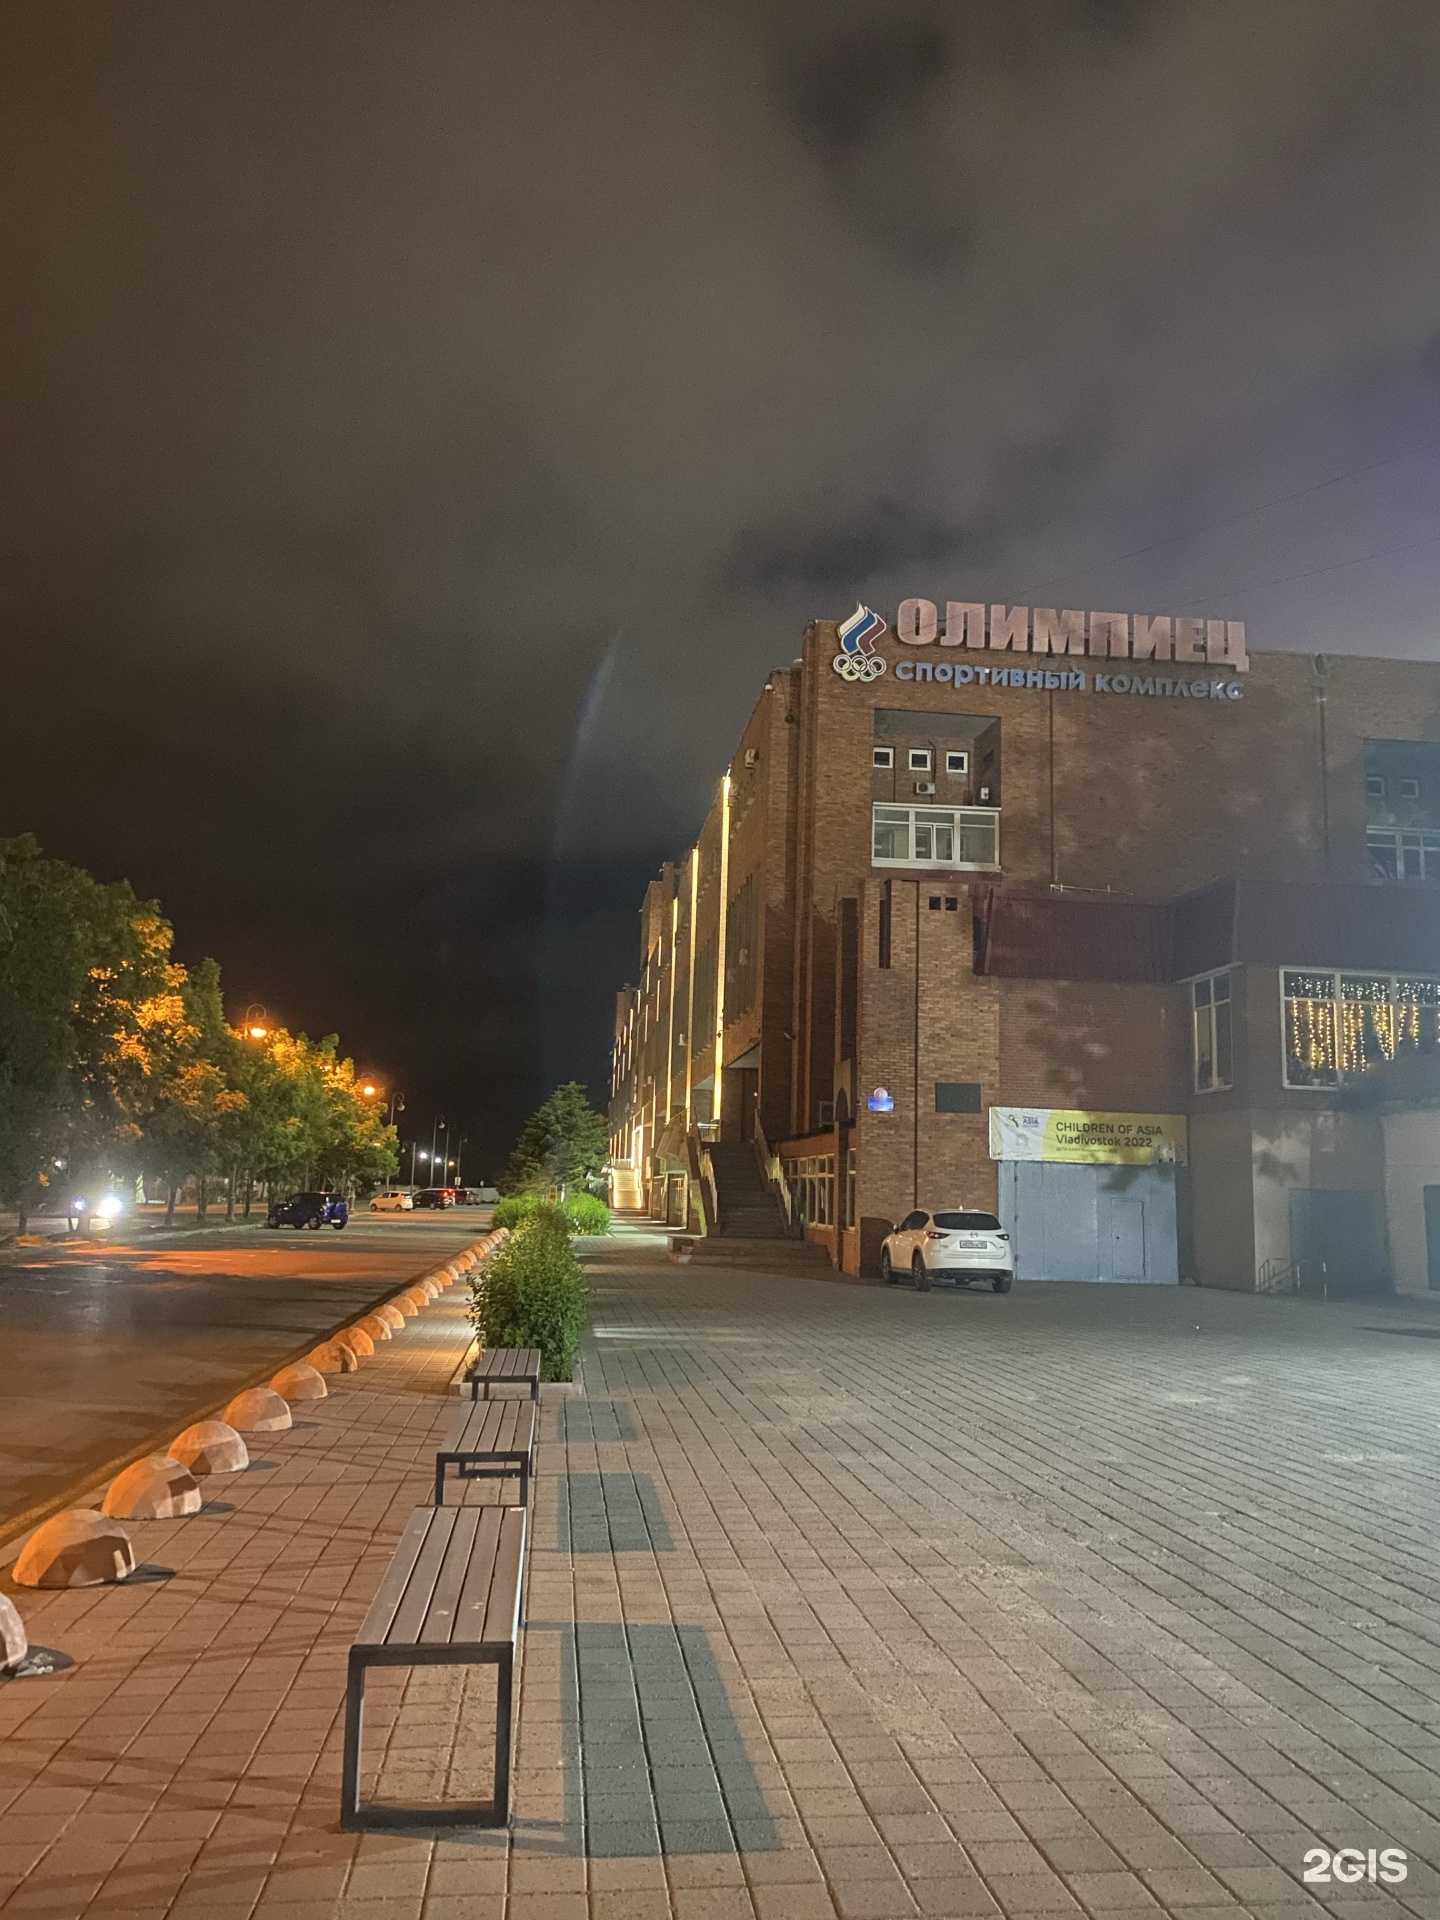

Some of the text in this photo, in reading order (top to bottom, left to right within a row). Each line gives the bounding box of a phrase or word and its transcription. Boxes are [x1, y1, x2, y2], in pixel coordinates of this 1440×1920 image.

[897, 598, 1249, 672] ОЛИМПИЕЦ
[1095, 673, 1245, 700] комплекс
[1056, 1121, 1163, 1136] CHILDREN OF ASIA
[1056, 1134, 1152, 1147] Vladivostok 2022
